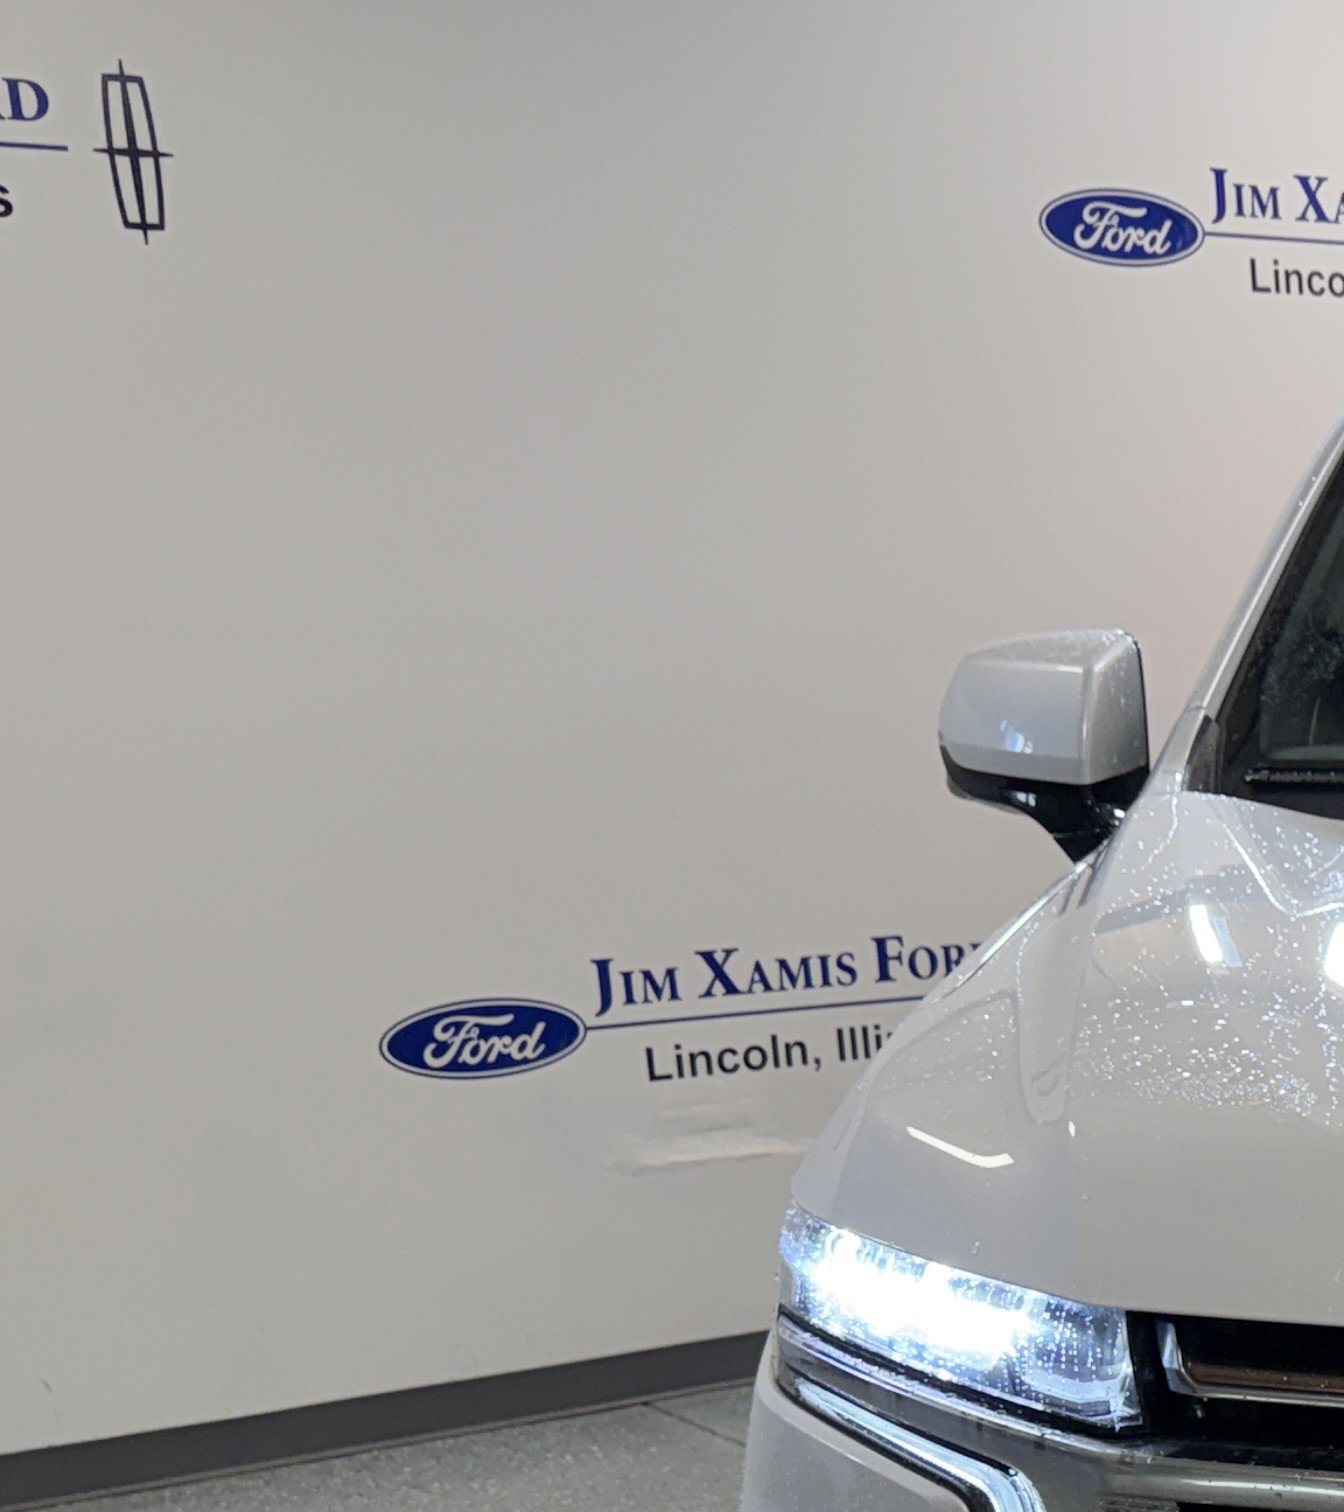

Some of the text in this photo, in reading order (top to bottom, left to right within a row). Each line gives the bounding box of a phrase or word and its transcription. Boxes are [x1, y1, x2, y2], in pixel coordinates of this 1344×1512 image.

[1209, 167, 1281, 225] JIM
[1073, 199, 1171, 256] Ford
[590, 934, 983, 1018] JIM XAMIS FOR
[422, 1013, 545, 1067] Ford
[645, 1033, 823, 1083] Lincoln,
